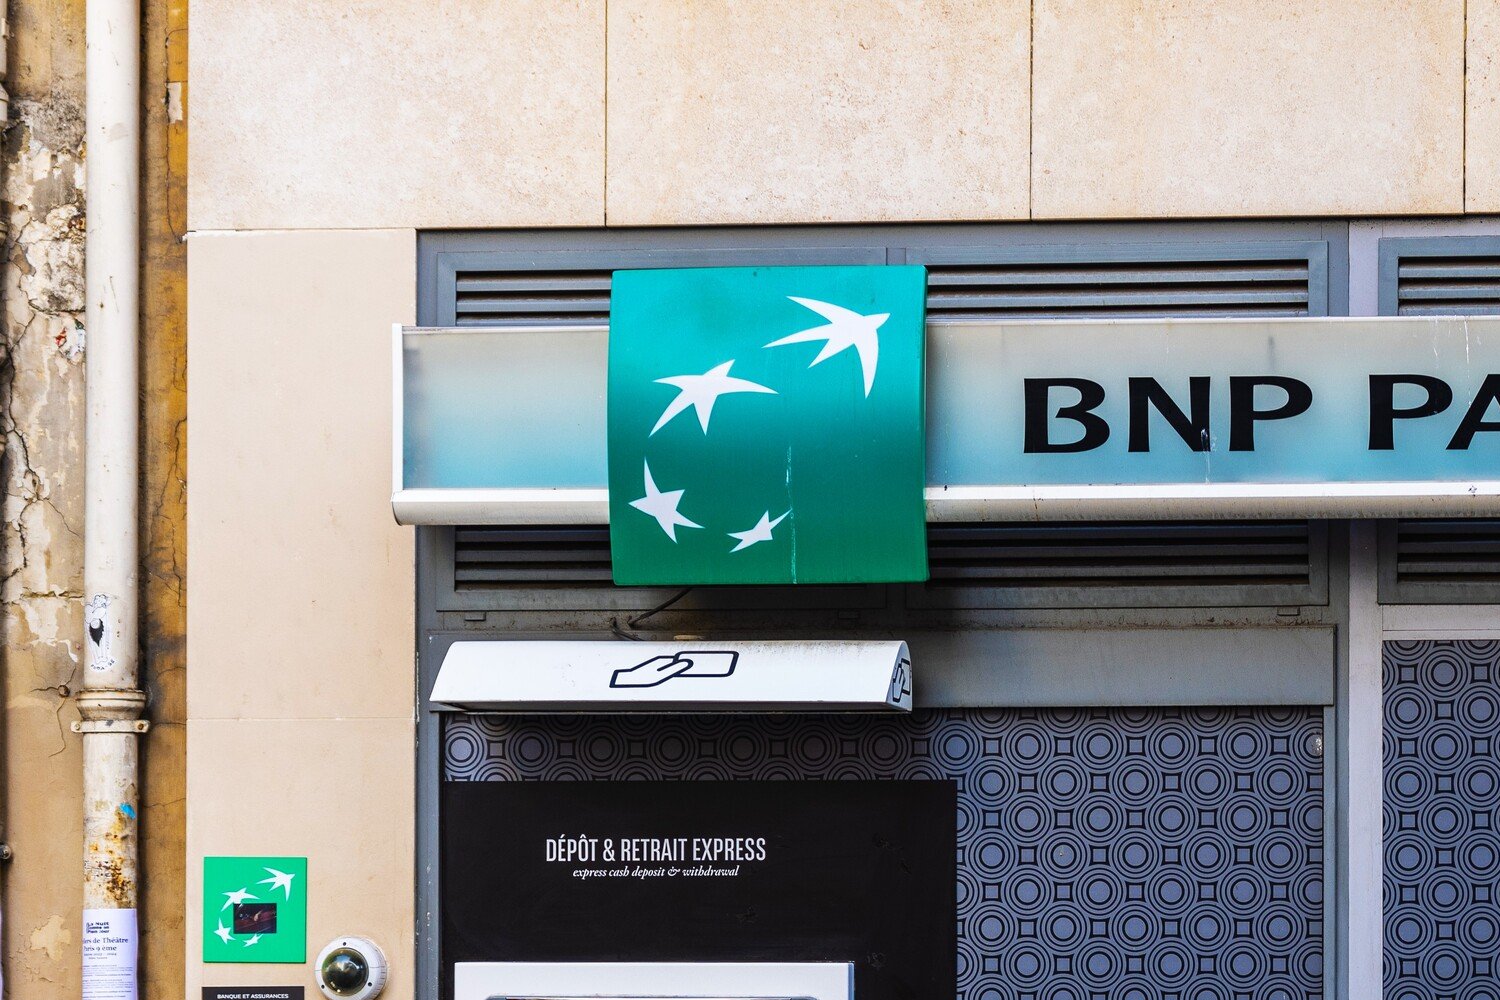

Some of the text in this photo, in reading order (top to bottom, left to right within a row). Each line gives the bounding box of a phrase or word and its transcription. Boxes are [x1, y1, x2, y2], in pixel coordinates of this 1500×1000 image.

[1023, 375, 1312, 453] BNP
[546, 835, 766, 862] DÉPÔT & RETRAIT EXPRESS
[573, 869, 608, 880] express
[610, 866, 629, 878] cash
[632, 867, 666, 880] deposit
[682, 866, 739, 878] withdrawal
